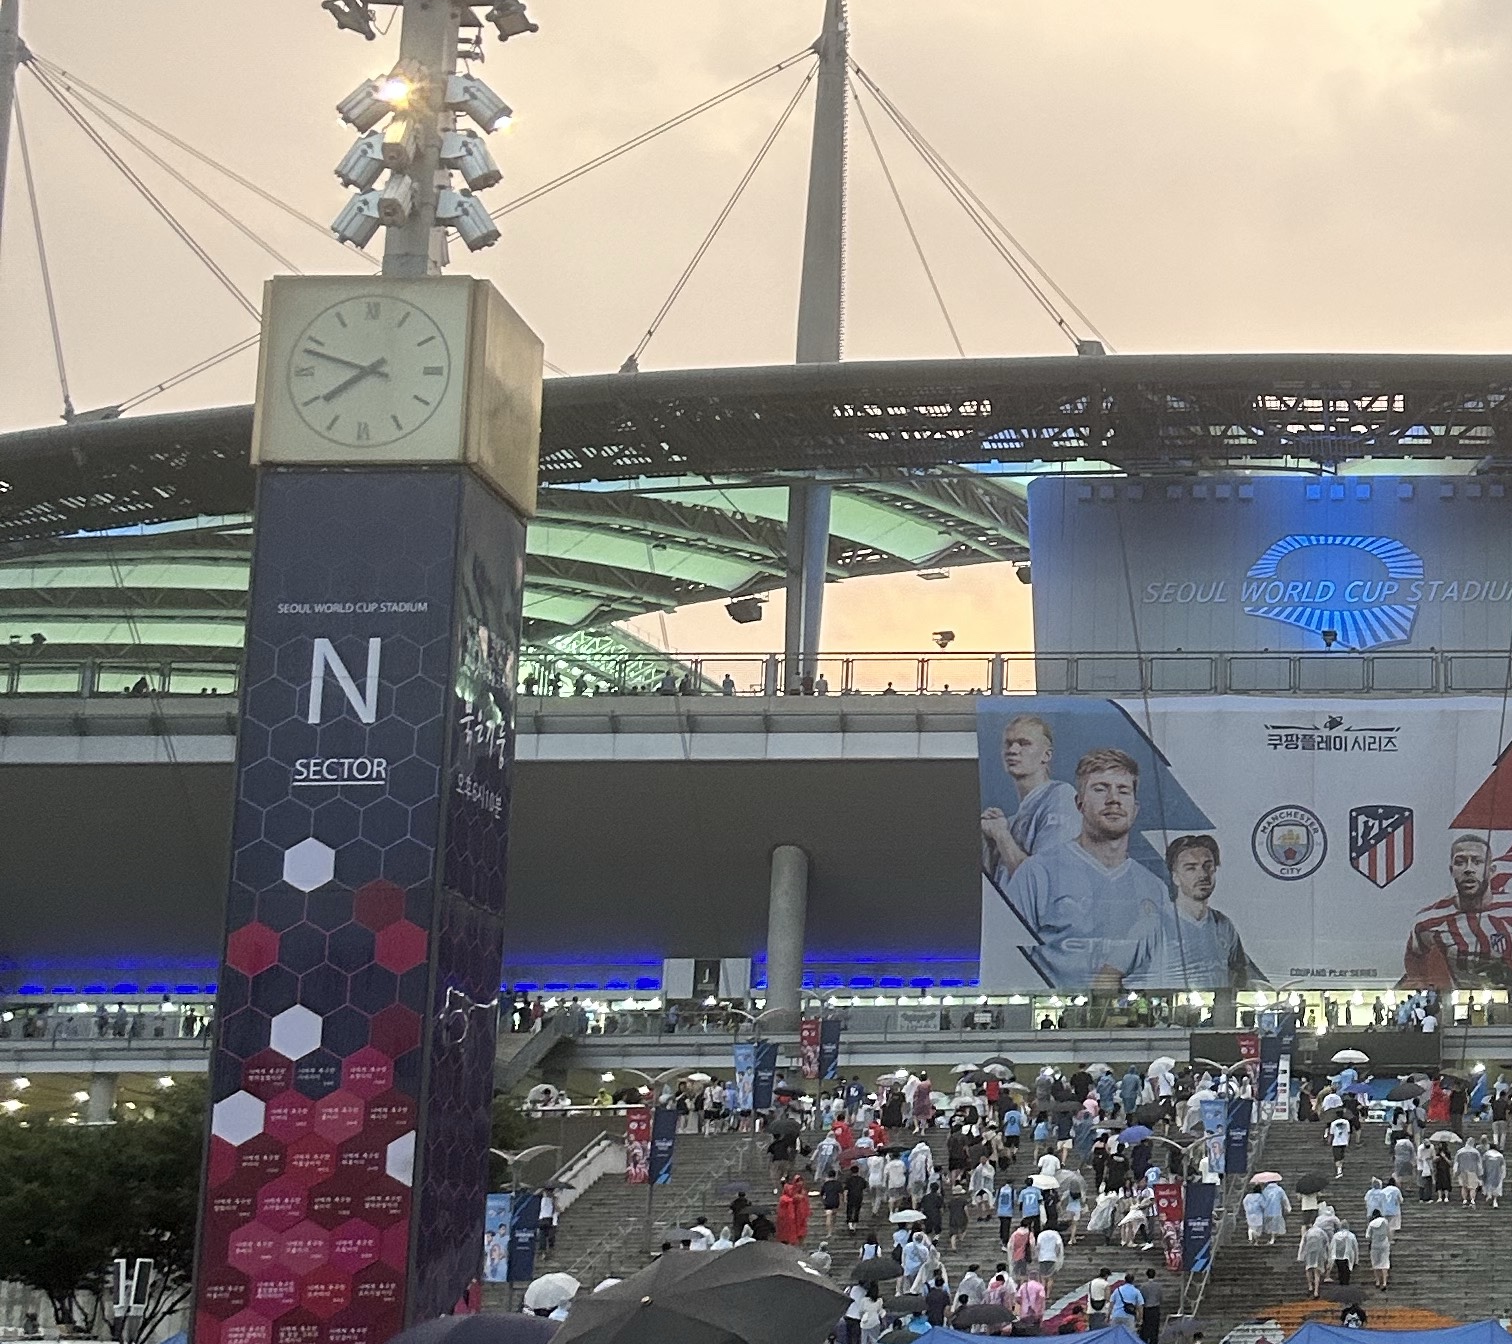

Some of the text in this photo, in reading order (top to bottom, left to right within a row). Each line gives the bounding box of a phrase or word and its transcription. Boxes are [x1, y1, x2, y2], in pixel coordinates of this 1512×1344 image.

[1142, 581, 1228, 604] SEOUL
[1240, 580, 1337, 603] WORLD
[1343, 580, 1399, 603] CUP
[277, 602, 428, 614] SEOUL WORLD CUP STADIUM
[307, 637, 382, 725] N
[1266, 733, 1399, 752] 쿠팡플레이 시리즈
[293, 758, 387, 779] SECTOR
[1260, 810, 1320, 836] MANCHESTER
[1279, 866, 1303, 876] CITY
[702, 968, 710, 984] J
